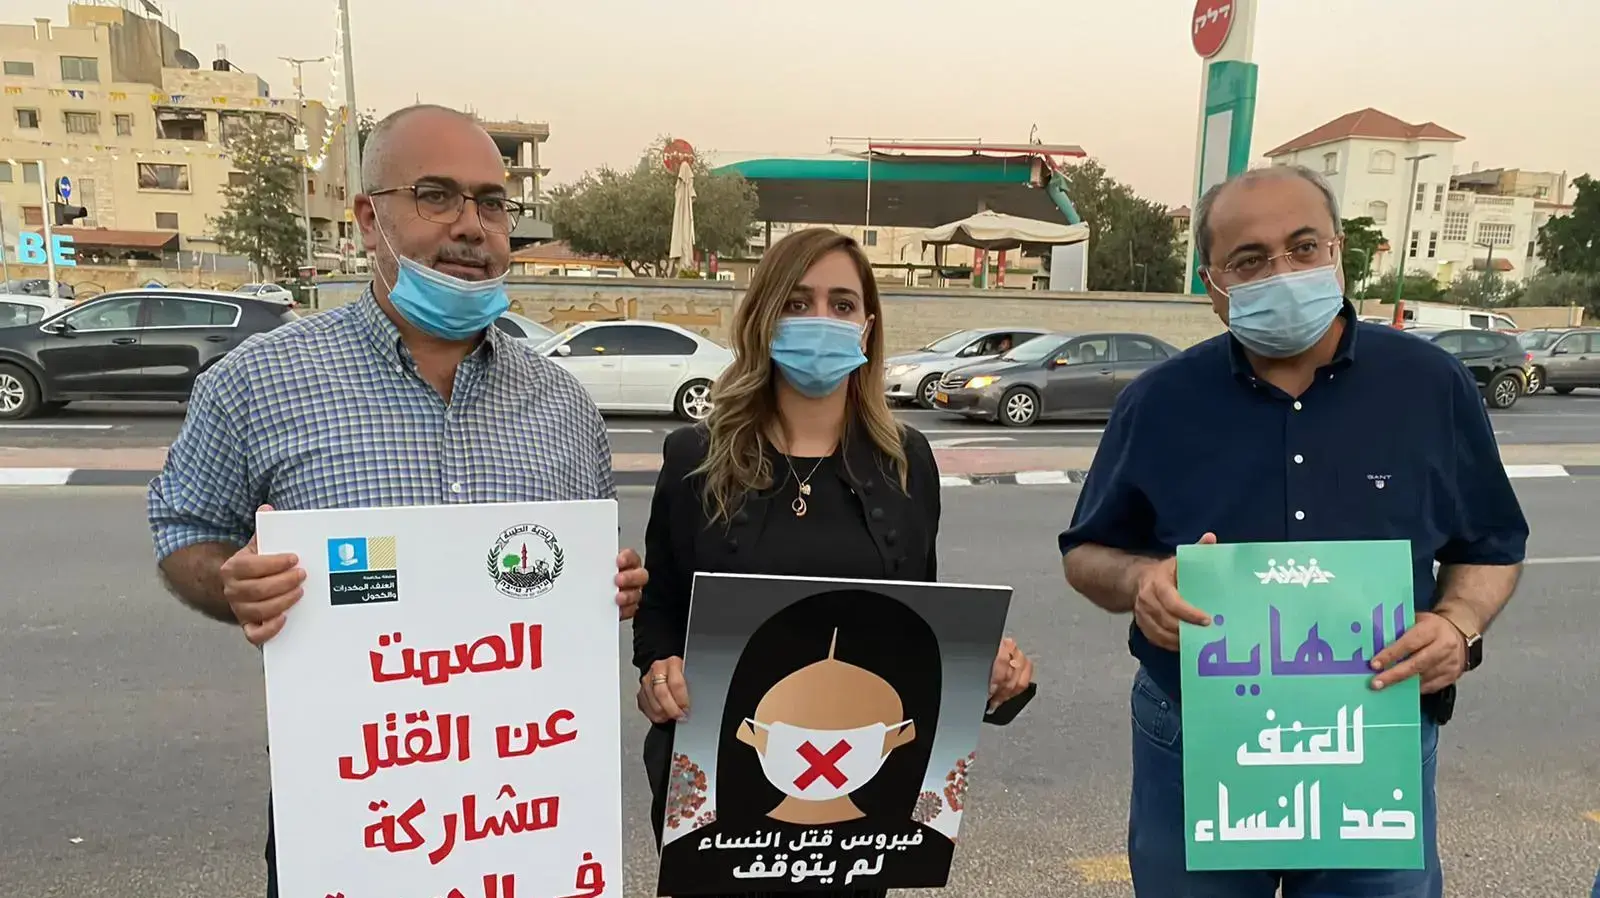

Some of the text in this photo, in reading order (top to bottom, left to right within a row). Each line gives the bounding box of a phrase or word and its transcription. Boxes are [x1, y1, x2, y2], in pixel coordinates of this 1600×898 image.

[1194, 4, 1231, 34] דלק
[503, 525, 551, 539] بلدية الطيبة
[333, 583, 369, 592] المخدرات
[361, 591, 397, 602] والكحول
[370, 622, 541, 685] الصمت
[338, 709, 578, 780] عن القتل
[1236, 704, 1365, 766] للعنف
[364, 784, 560, 864] مشاركة
[1194, 780, 1416, 842] ضد النساء
[698, 829, 923, 851] فيروس قتل النساء
[732, 853, 884, 885] لم يتوقف
